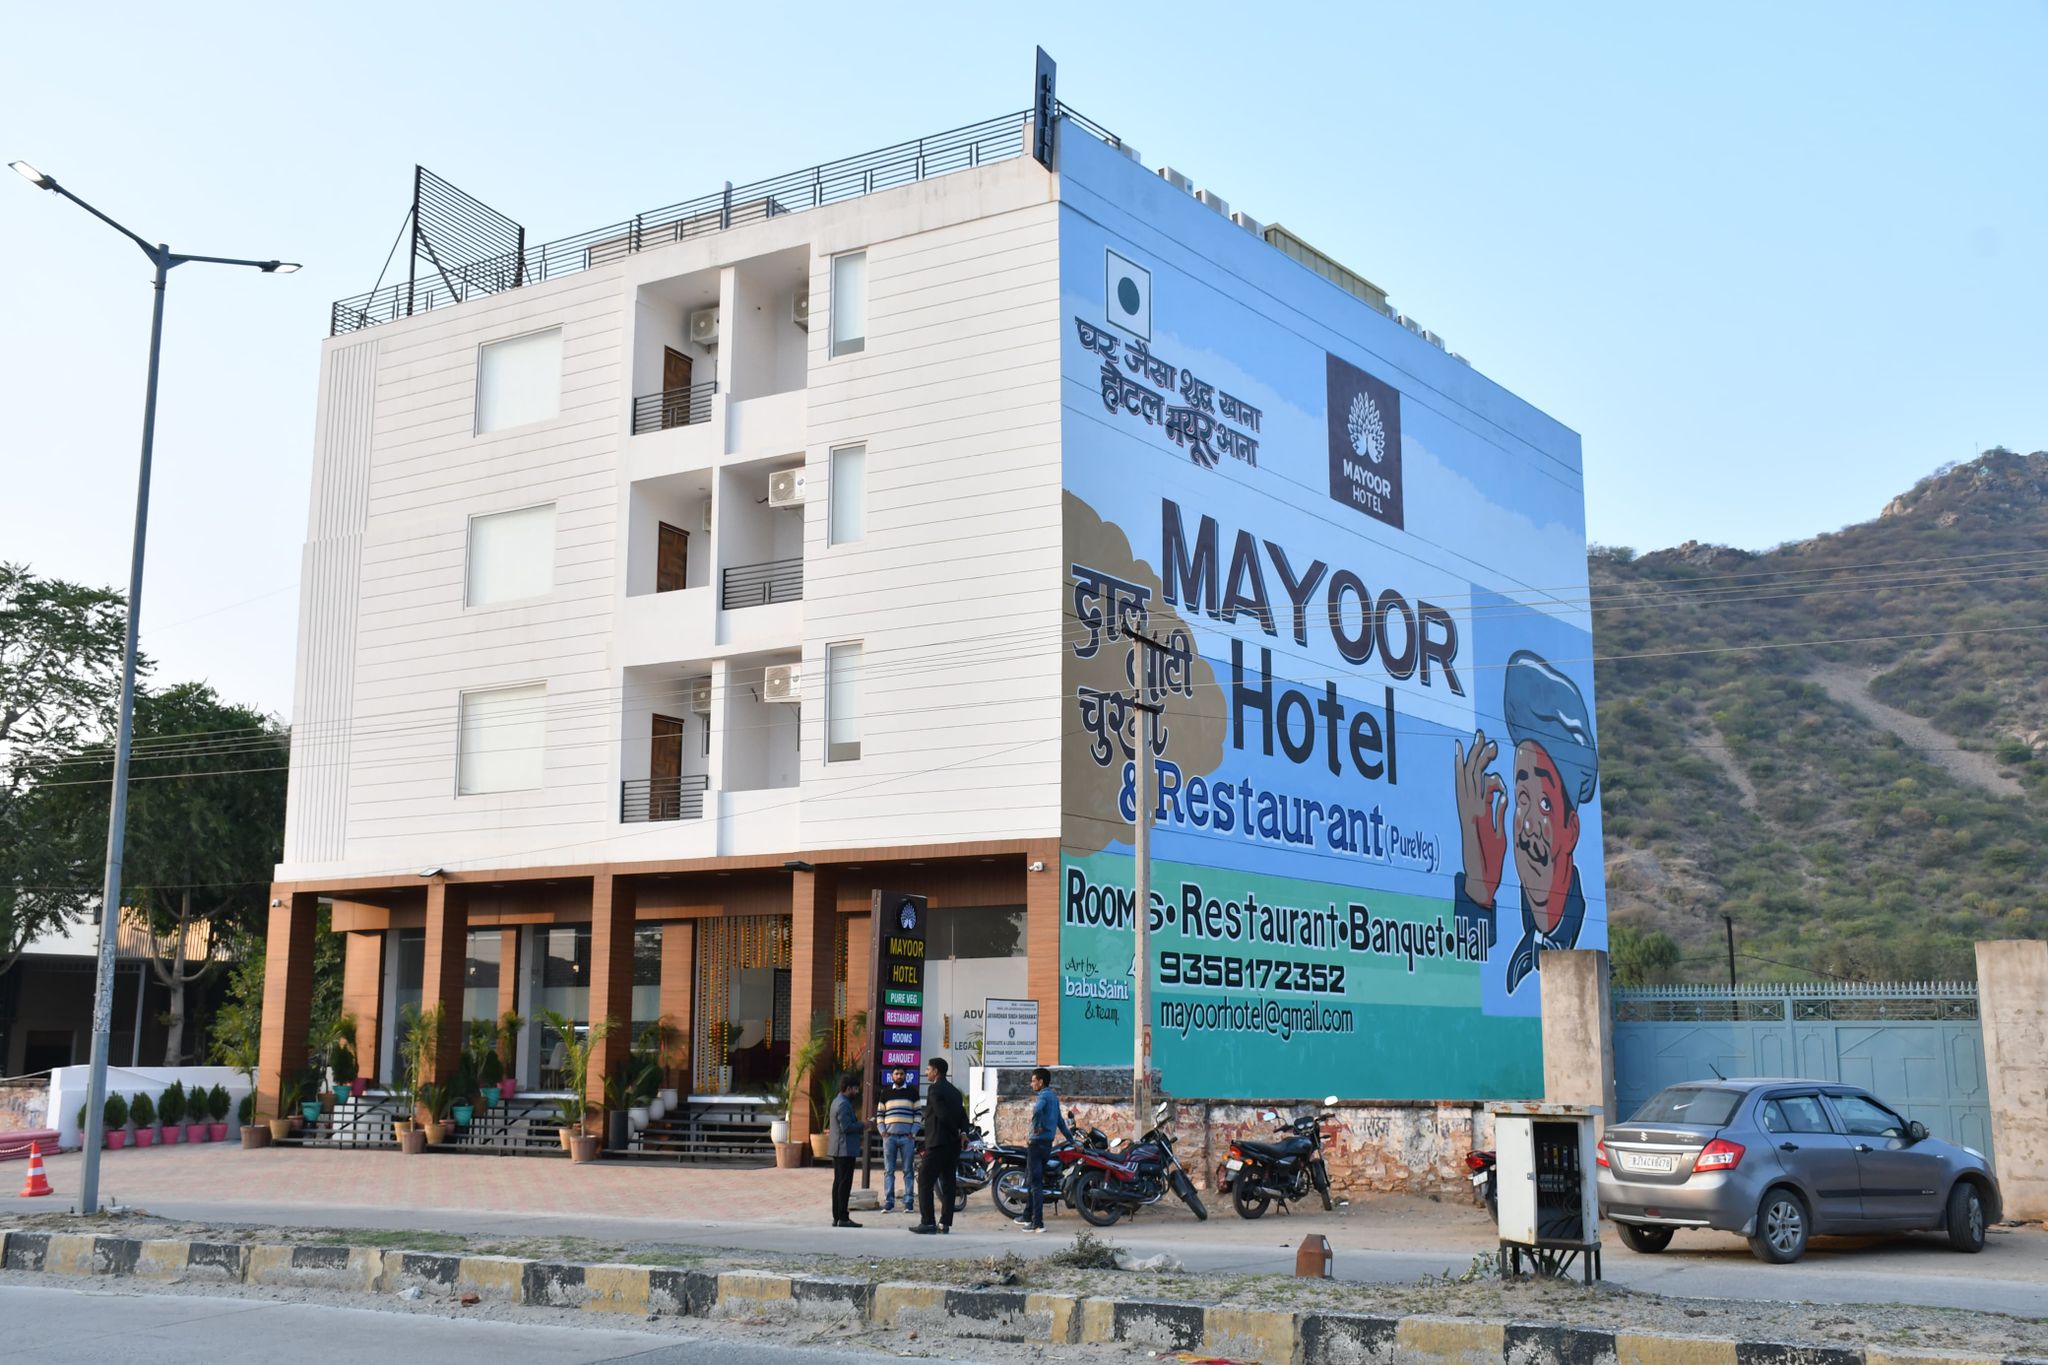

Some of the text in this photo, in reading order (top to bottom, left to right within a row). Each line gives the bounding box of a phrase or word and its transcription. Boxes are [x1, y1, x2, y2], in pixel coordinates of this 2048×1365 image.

[1075, 316, 1120, 363] घर
[1124, 339, 1177, 391] जैसा
[1218, 390, 1263, 433] खाना
[1165, 404, 1220, 469] मयूर
[1217, 423, 1260, 468] आना
[1343, 458, 1391, 499] MAYOOR
[1353, 485, 1383, 514] HOTEL
[1162, 497, 1466, 697] MAYOOR
[1231, 638, 1397, 785] Hotel
[1155, 759, 1385, 858] Restaurant
[890, 937, 924, 958] MAYOOR
[1181, 881, 1339, 949] Restaurant
[1349, 904, 1445, 973] Banquet
[1456, 916, 1489, 963] Hall
[893, 965, 918, 984] HOTEL
[1160, 951, 1346, 994] 9358172352
[887, 1012, 919, 1023] RESTAURANT
[890, 993, 918, 1004] PURE VEG
[1160, 997, 1354, 1040] mayoorhotel@gmail.com
[888, 1053, 914, 1063] BANQUET
[892, 1032, 913, 1043] ROOMS
[955, 1041, 977, 1051] LEGAL
